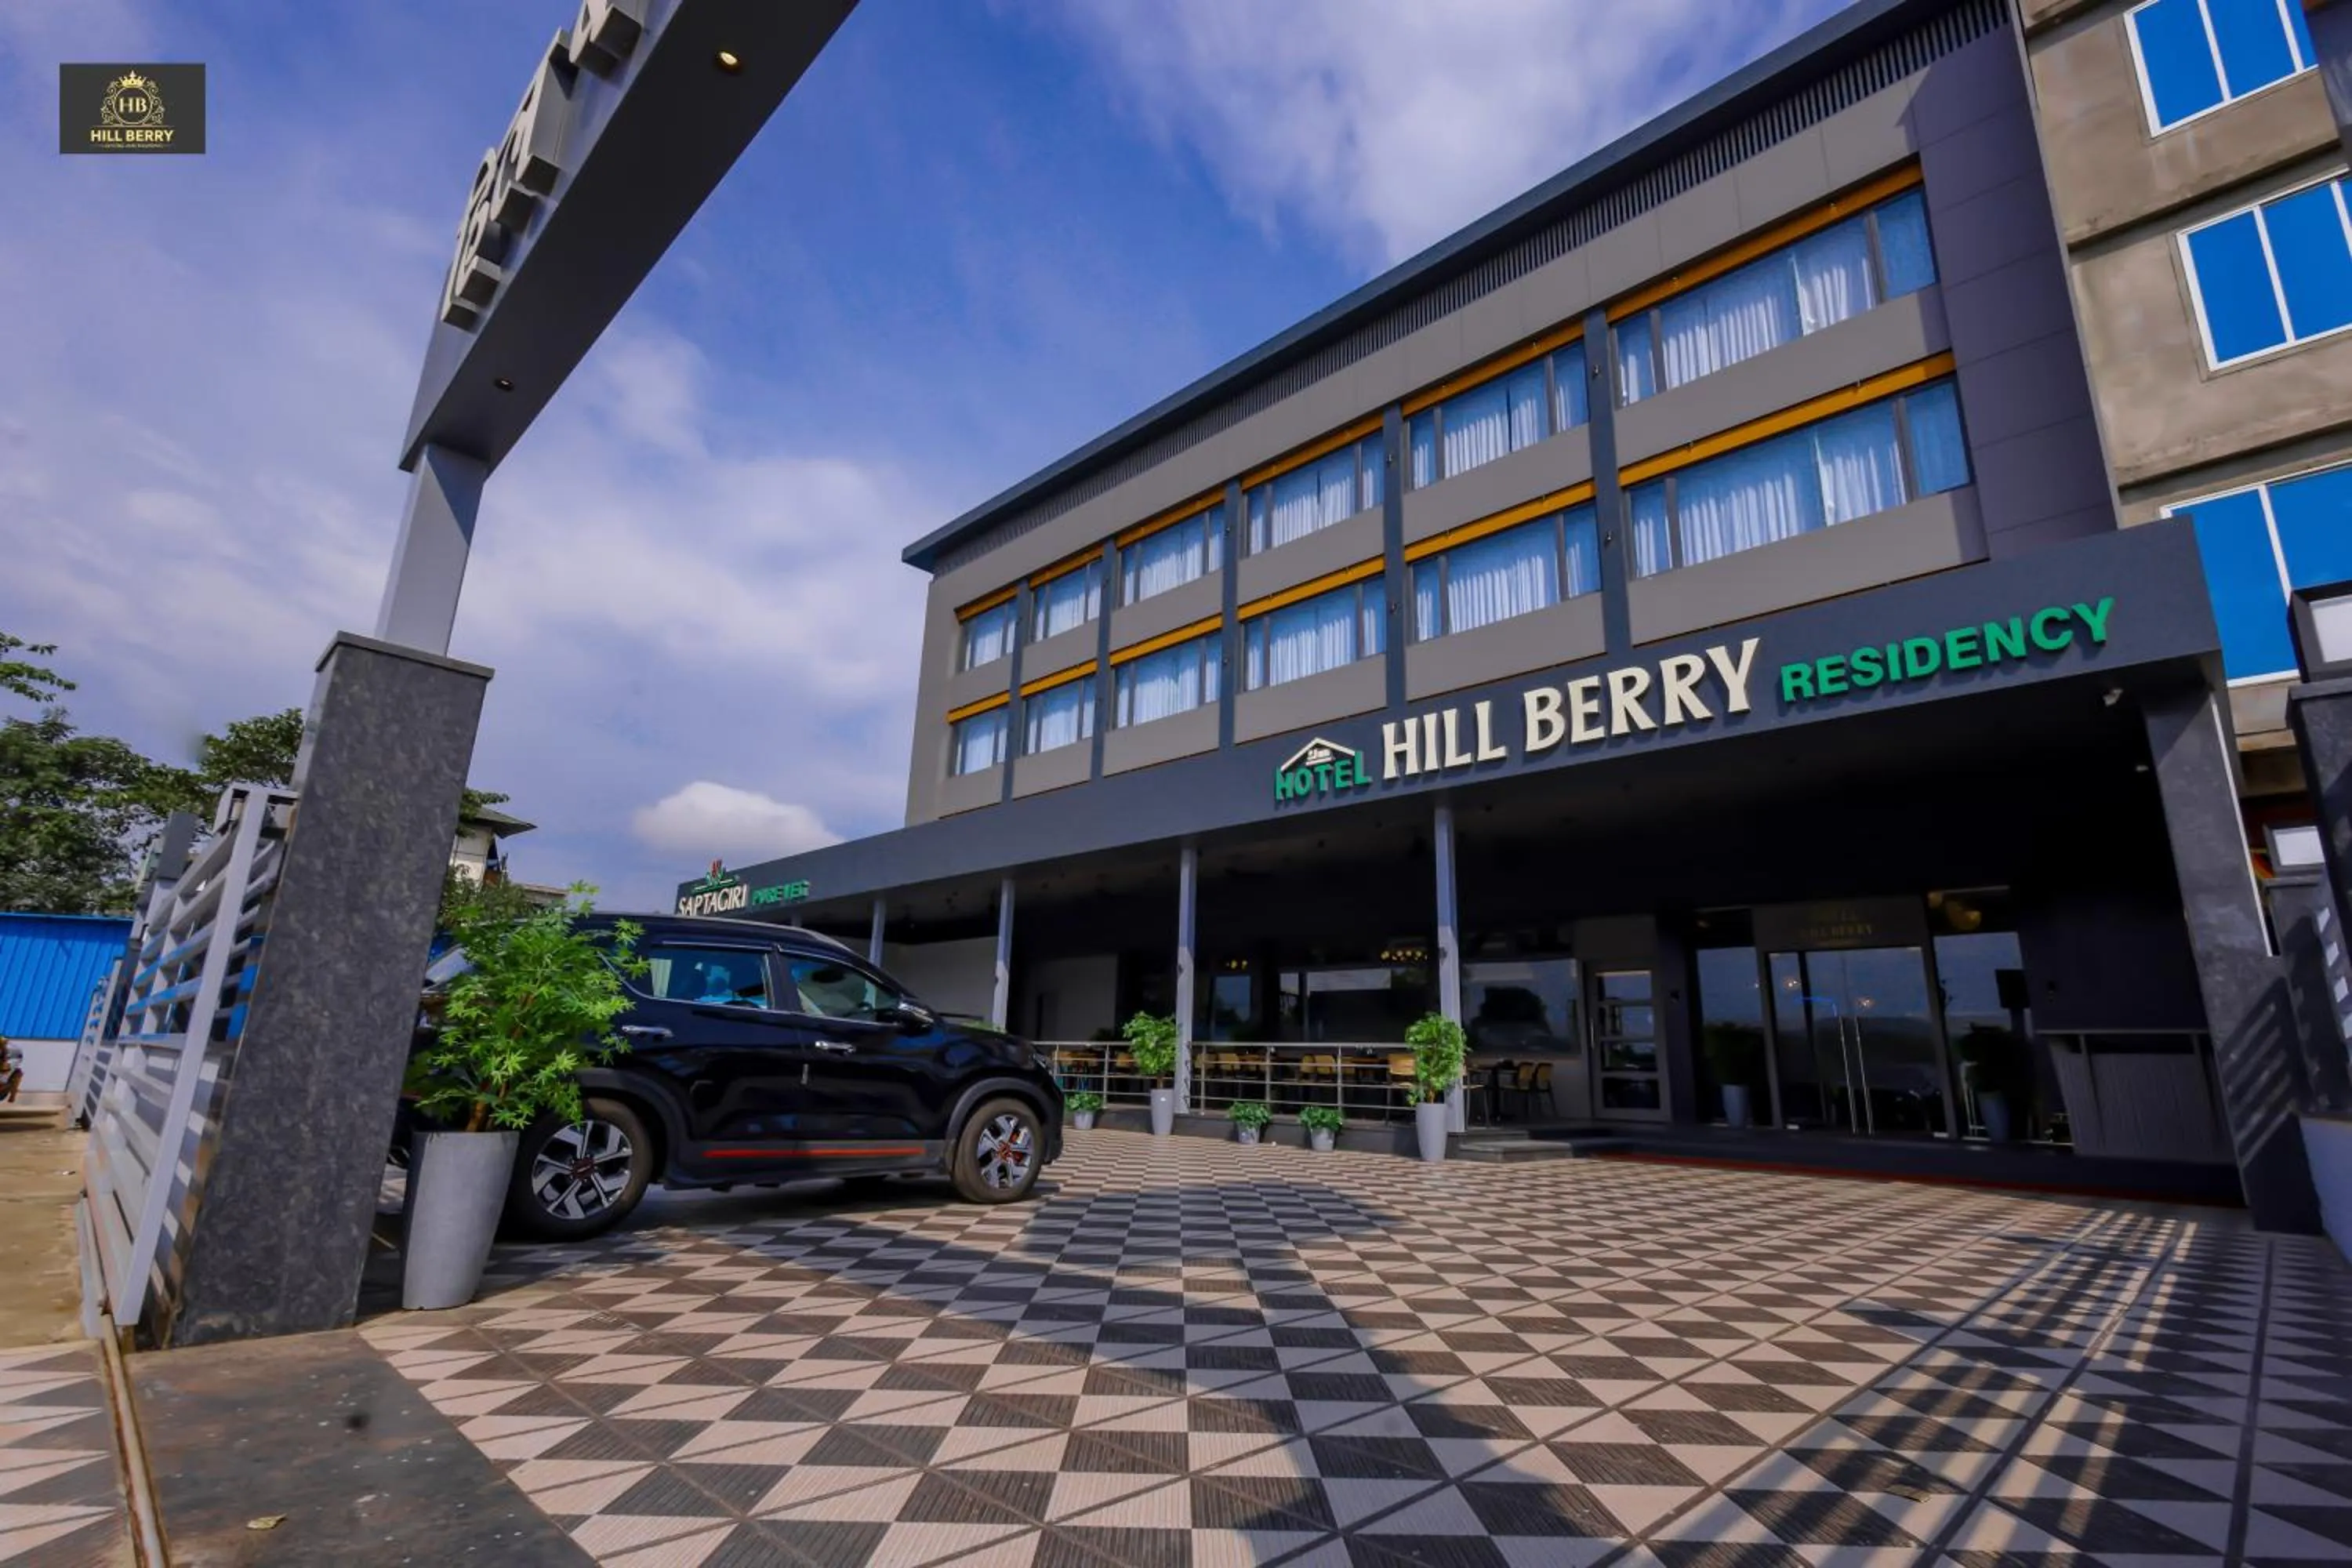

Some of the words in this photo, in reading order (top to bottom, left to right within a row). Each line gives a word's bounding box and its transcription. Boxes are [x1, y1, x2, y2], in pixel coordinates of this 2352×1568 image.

[1276, 750, 1372, 800] HOTEL
[1382, 700, 1508, 780] HILL
[1523, 637, 1760, 753] BERRY
[1780, 597, 2114, 702] RESIDENCY
[678, 883, 749, 916] SAPTAGIRI
